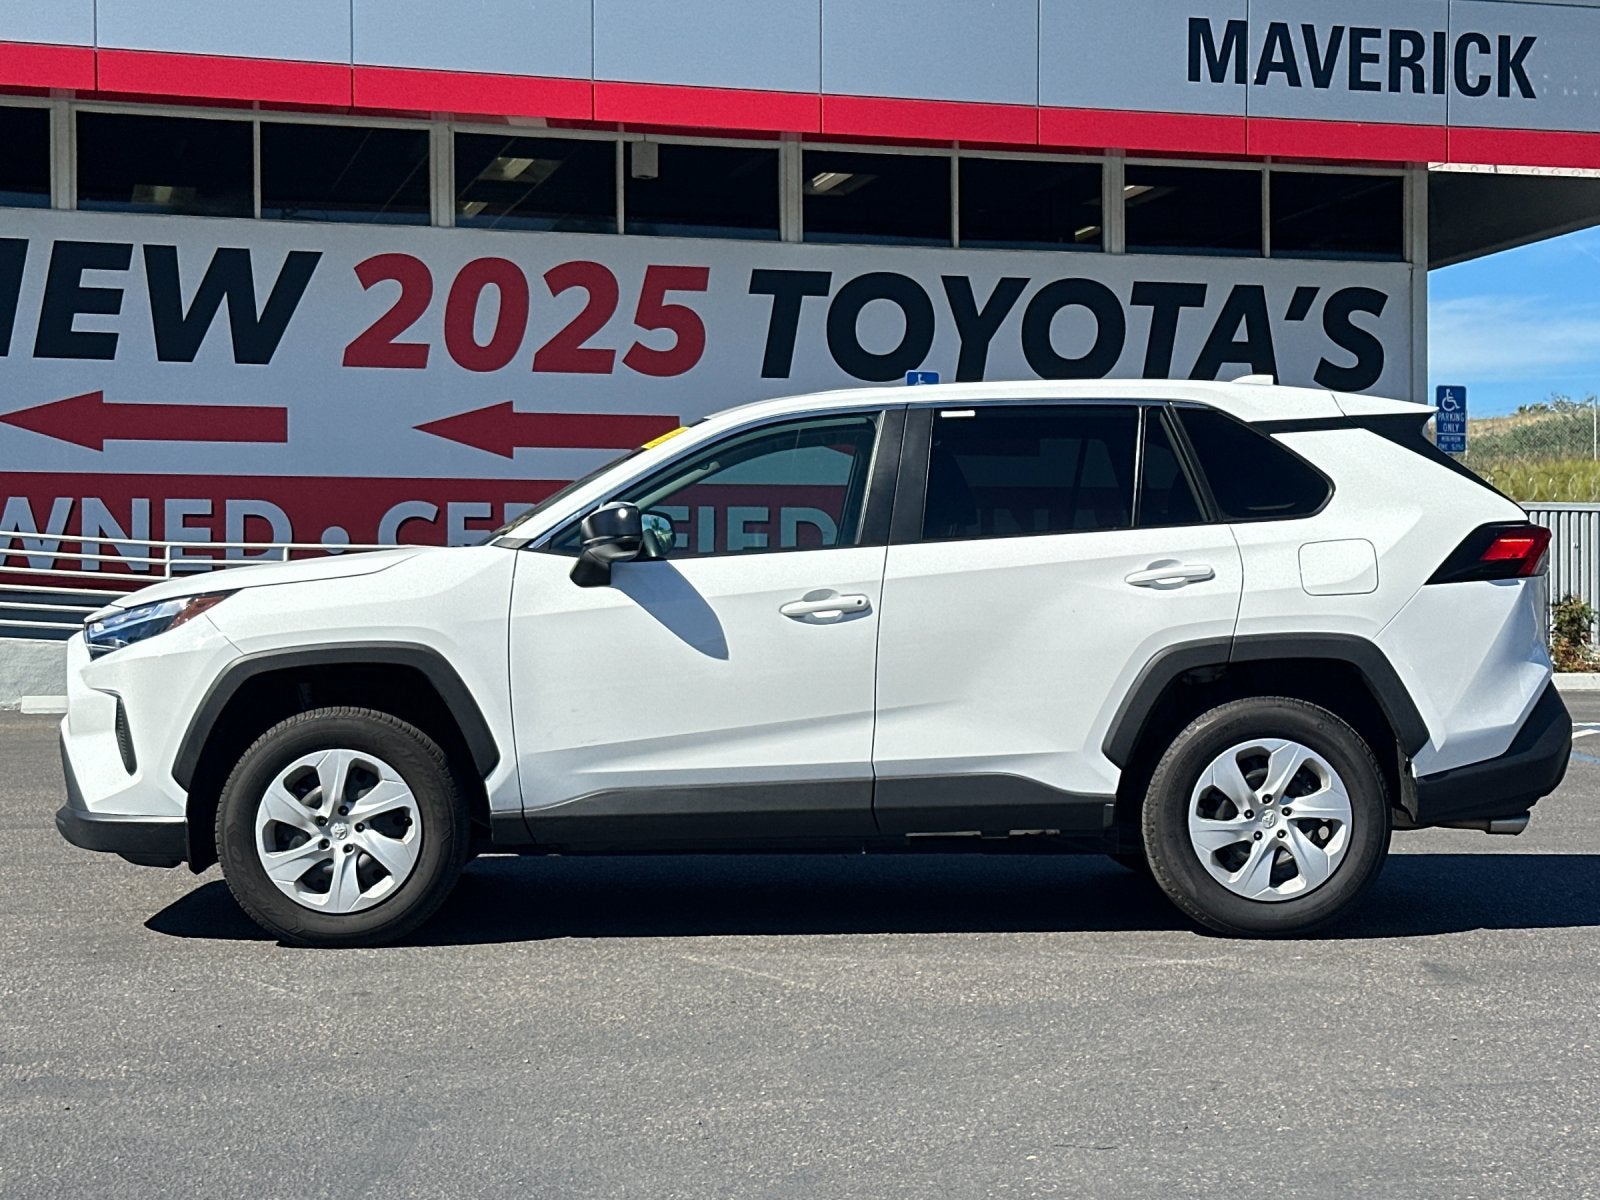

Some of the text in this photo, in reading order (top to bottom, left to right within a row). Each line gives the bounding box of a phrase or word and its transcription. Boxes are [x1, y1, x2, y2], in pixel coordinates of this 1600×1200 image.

[1188, 17, 1538, 99] MAVERICK
[342, 252, 711, 377] 2025
[748, 268, 1389, 393] TOYOTA'S
[1438, 412, 1465, 423] PARKING
[1442, 423, 1460, 433] ONLY
